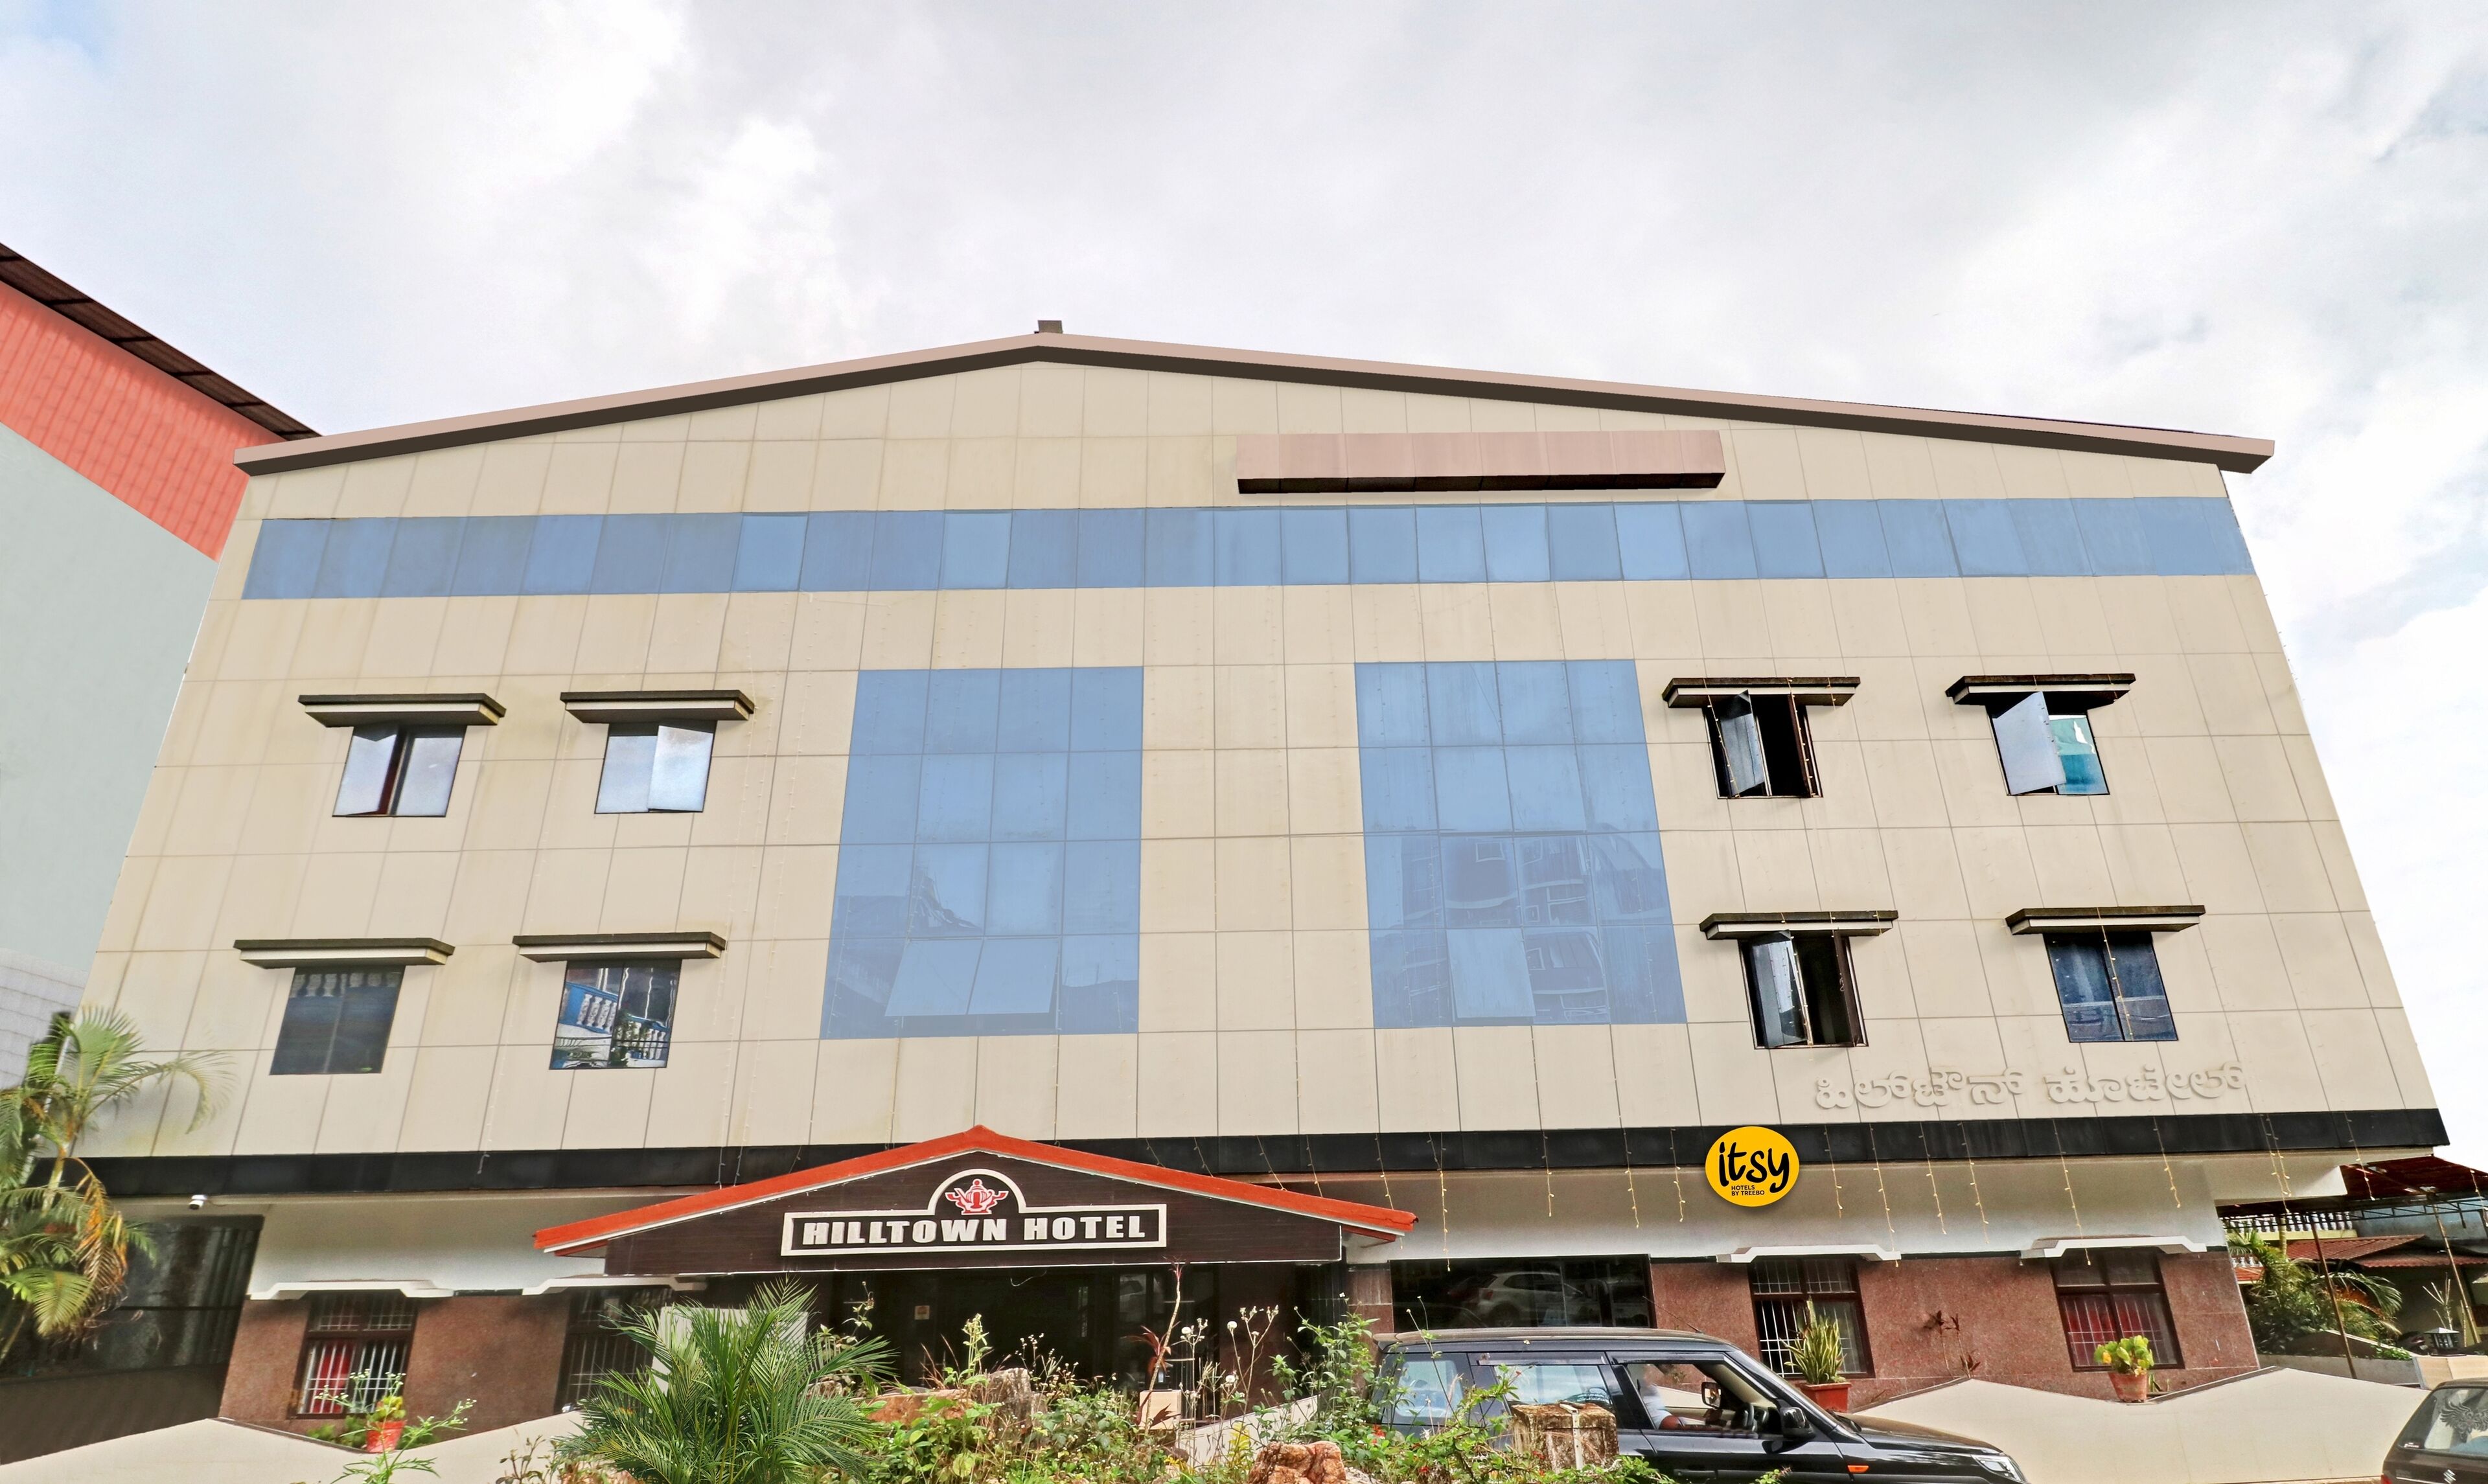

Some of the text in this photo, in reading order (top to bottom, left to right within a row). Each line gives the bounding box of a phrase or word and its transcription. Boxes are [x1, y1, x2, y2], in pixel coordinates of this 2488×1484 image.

[1719, 1142, 1790, 1193] itsy
[802, 1215, 1146, 1245] HILLTOWN HOTEL
